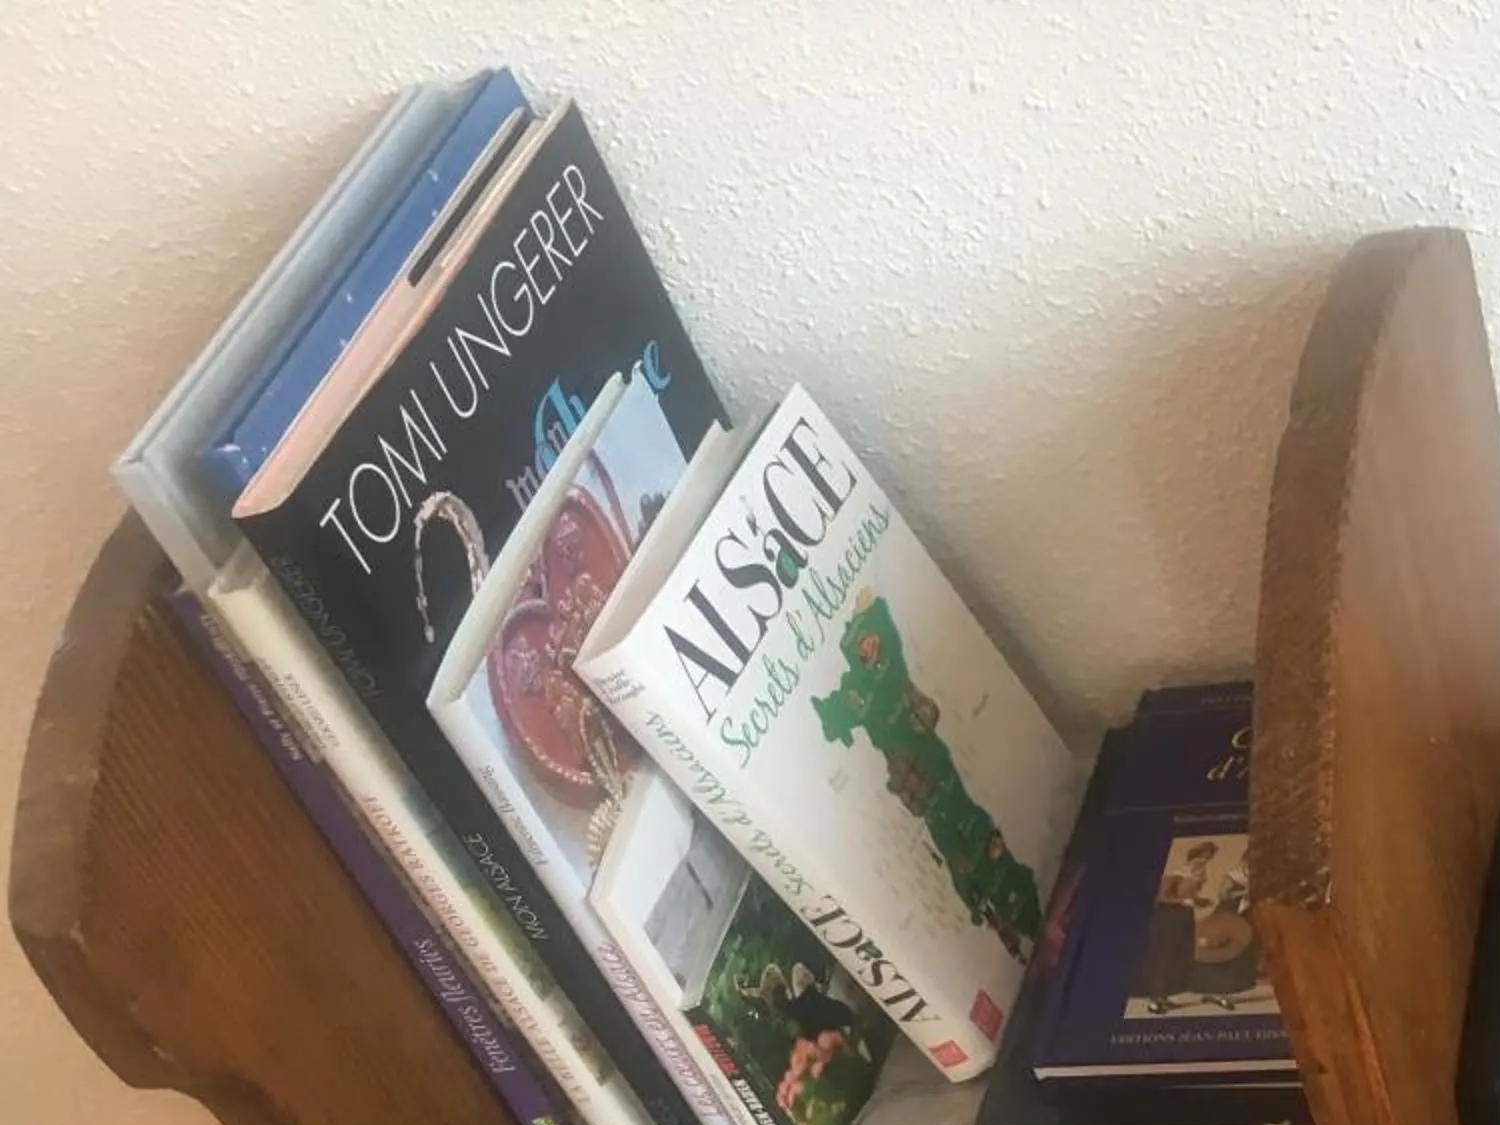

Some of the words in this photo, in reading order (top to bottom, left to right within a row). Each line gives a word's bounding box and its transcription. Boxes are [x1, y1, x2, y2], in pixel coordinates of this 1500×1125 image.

[319, 388, 447, 575] TOMI
[429, 163, 605, 419] UNGERER
[719, 654, 801, 770] Secrets
[464, 832, 518, 891] ALSACE
[751, 828, 815, 896] Secrets
[507, 895, 549, 940] MON
[415, 937, 478, 1004] fleuries
[458, 1003, 517, 1075] Fenêtres
